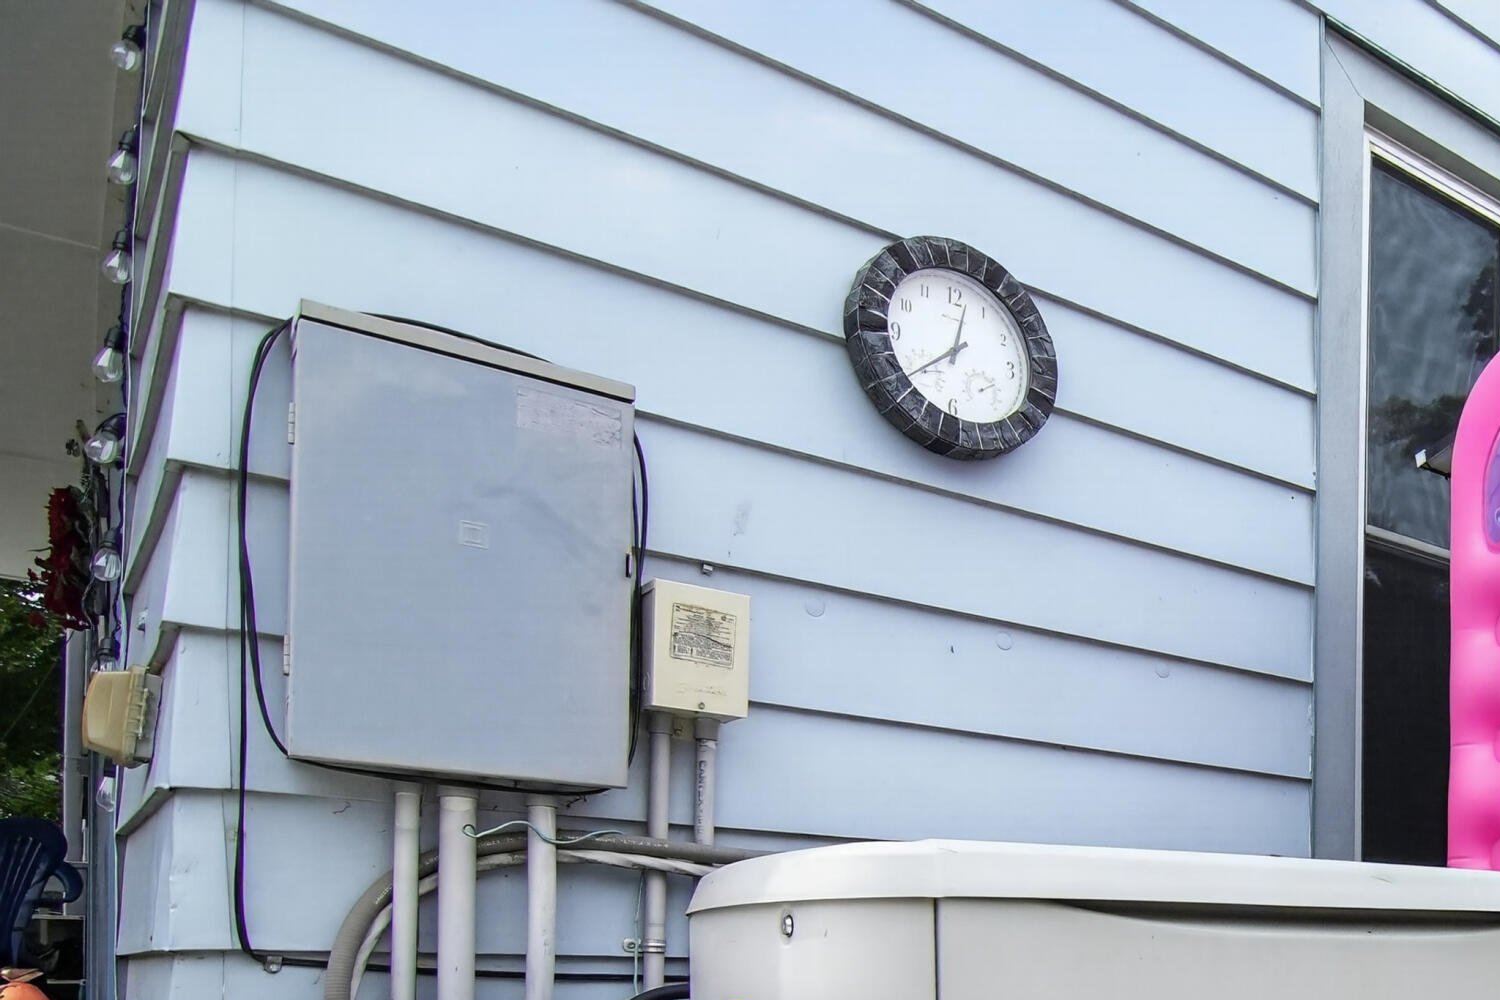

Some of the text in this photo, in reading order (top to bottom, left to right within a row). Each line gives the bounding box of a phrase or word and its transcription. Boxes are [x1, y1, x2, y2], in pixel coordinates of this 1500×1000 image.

[920, 284, 929, 299] 11
[947, 286, 962, 307] 12
[901, 298, 912, 313] 10
[890, 322, 900, 341] 9
[1000, 333, 1007, 347] 2
[1006, 361, 1014, 379] 3
[948, 398, 957, 416] 6
